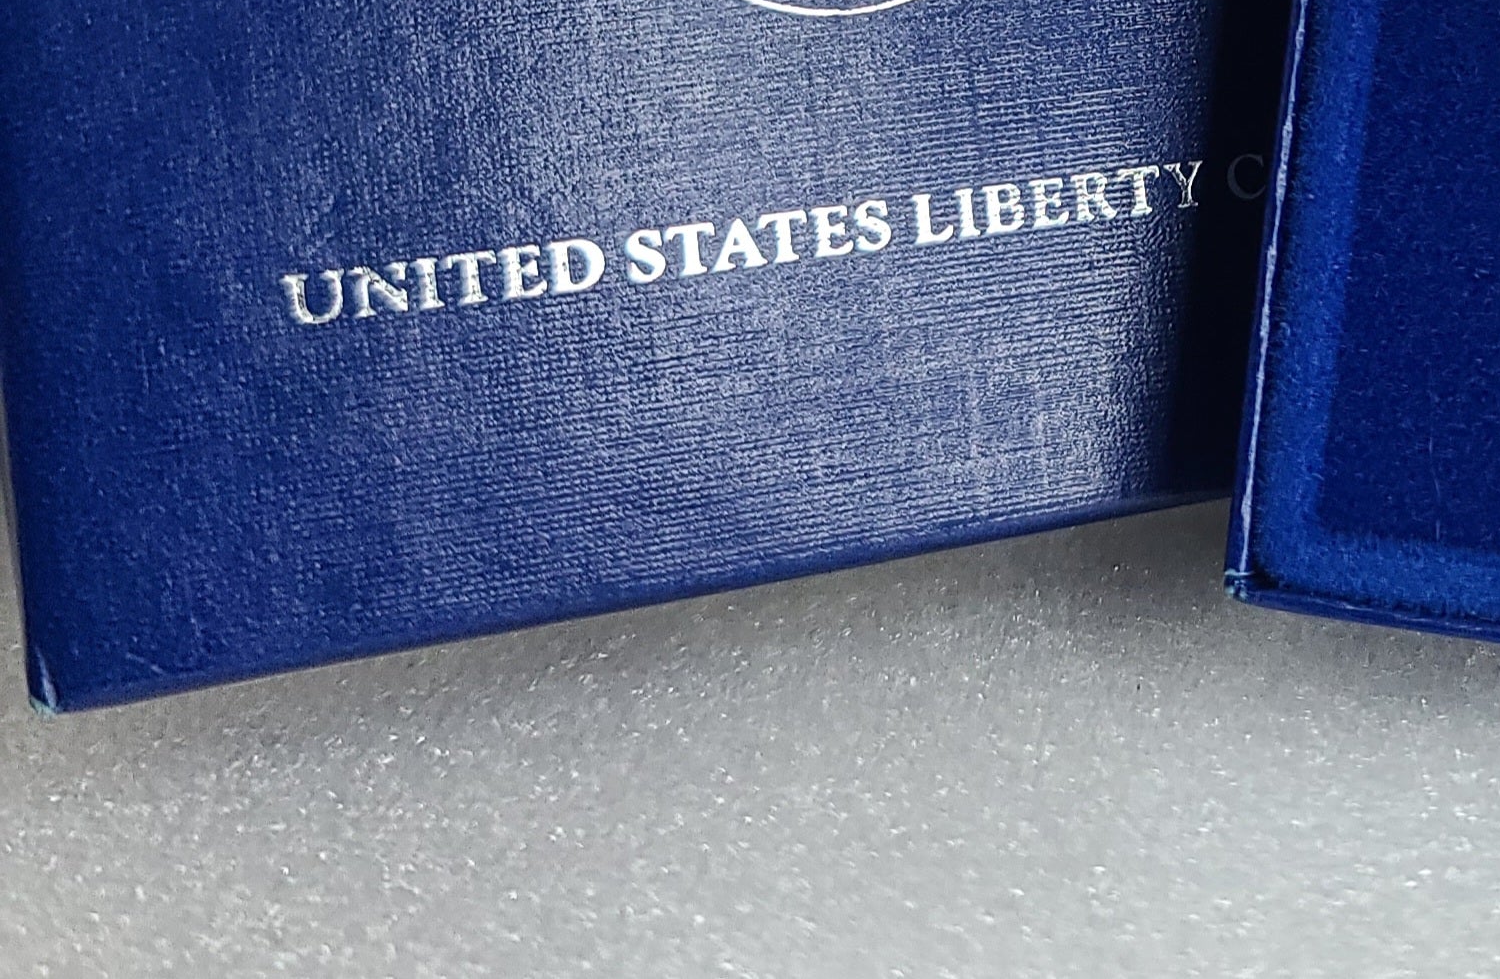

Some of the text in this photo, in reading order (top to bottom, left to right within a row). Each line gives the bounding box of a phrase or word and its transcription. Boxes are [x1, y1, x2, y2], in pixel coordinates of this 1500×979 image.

[281, 238, 605, 327] UNITED
[626, 199, 890, 285] STATES
[911, 159, 1202, 245] LIBERTY
